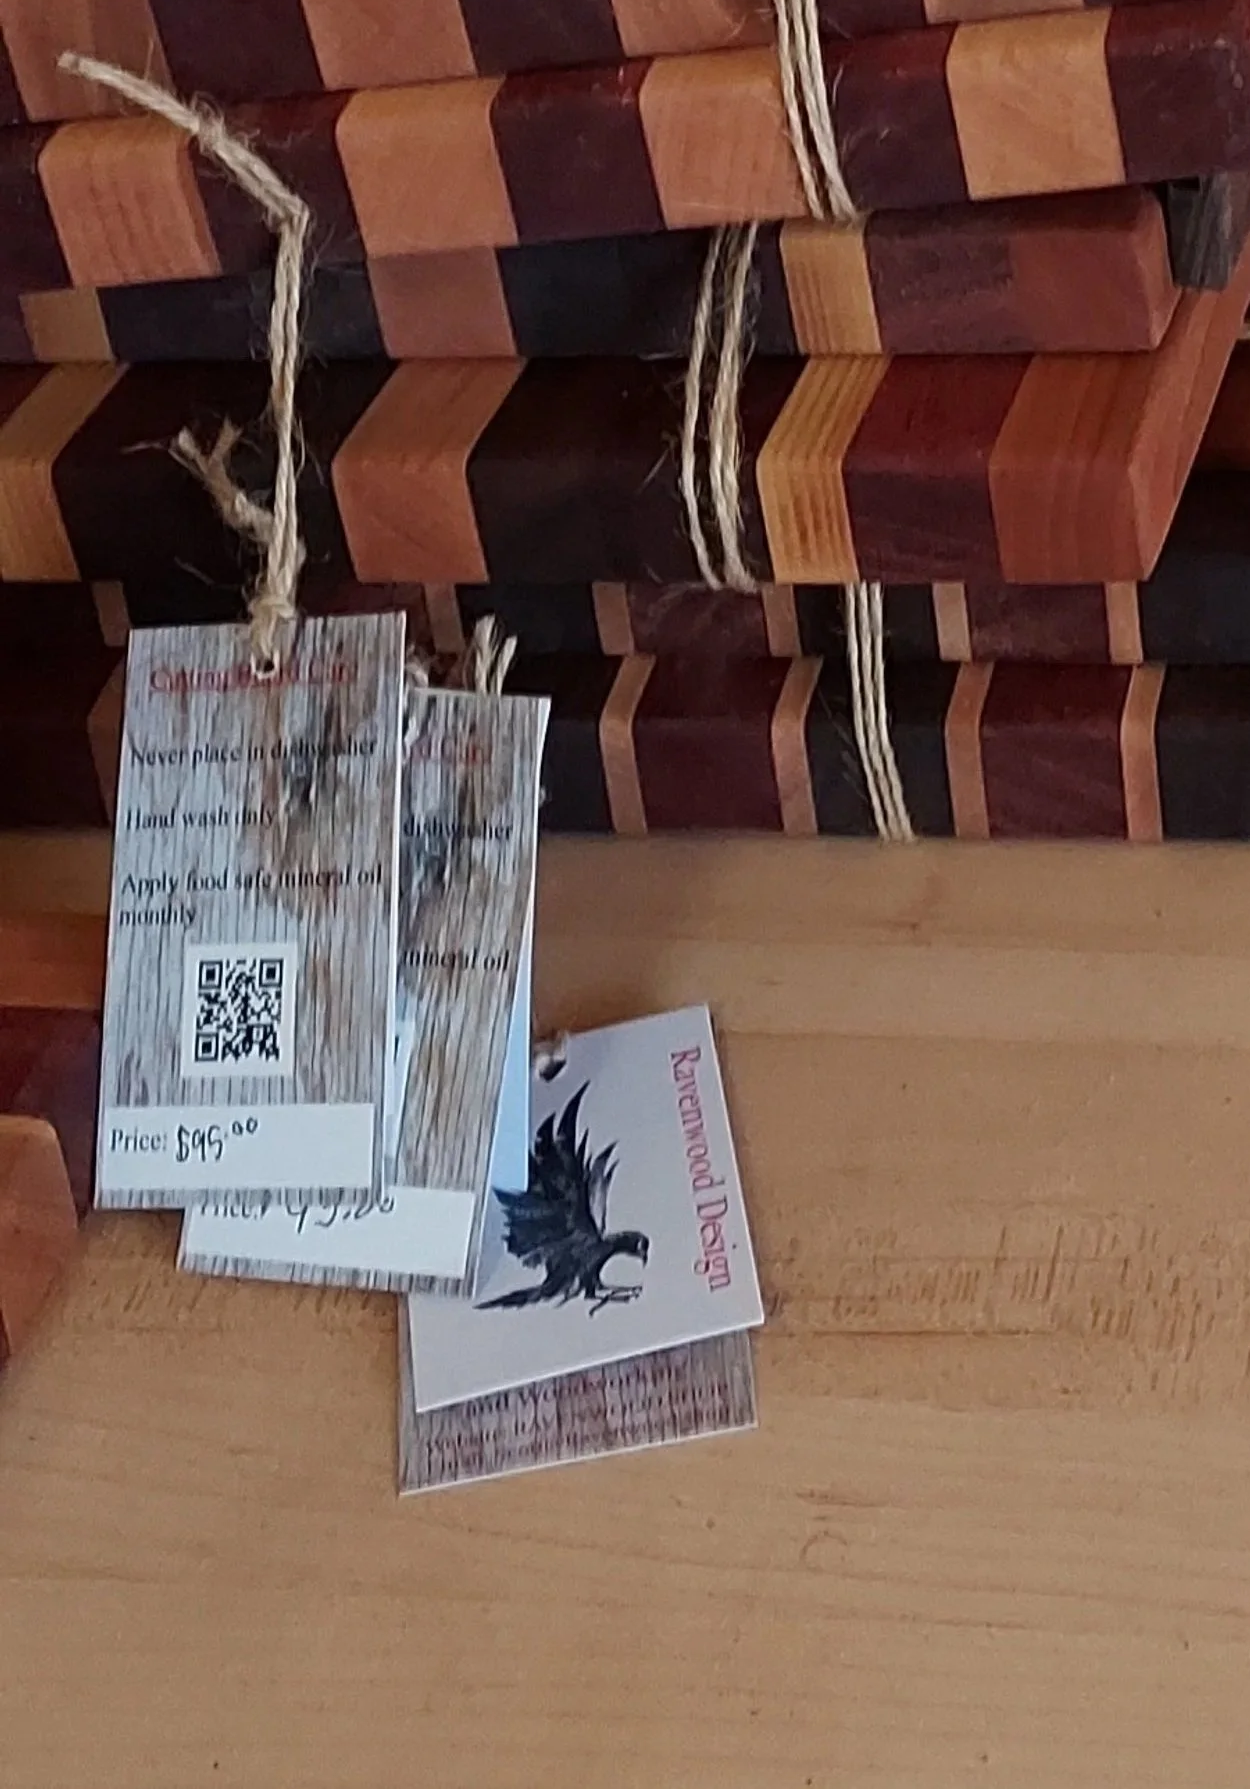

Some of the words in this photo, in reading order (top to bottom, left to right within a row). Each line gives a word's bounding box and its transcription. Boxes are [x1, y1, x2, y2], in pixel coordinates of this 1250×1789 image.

[131, 741, 185, 768] Never
[191, 741, 242, 770] place
[247, 740, 265, 761] in
[271, 733, 377, 762] dishwasher
[127, 806, 176, 831] Hand
[182, 804, 229, 829] wash
[235, 804, 275, 828] only
[121, 869, 179, 899] Apply
[187, 865, 228, 892] food
[234, 865, 272, 889] safe
[278, 863, 352, 889] mineral
[357, 863, 382, 886] oil
[119, 902, 197, 928] monthly
[483, 948, 510, 971] oil
[670, 1046, 725, 1194] Ravenwood
[110, 1125, 167, 1153] Price:
[692, 1194, 738, 1294] Design
